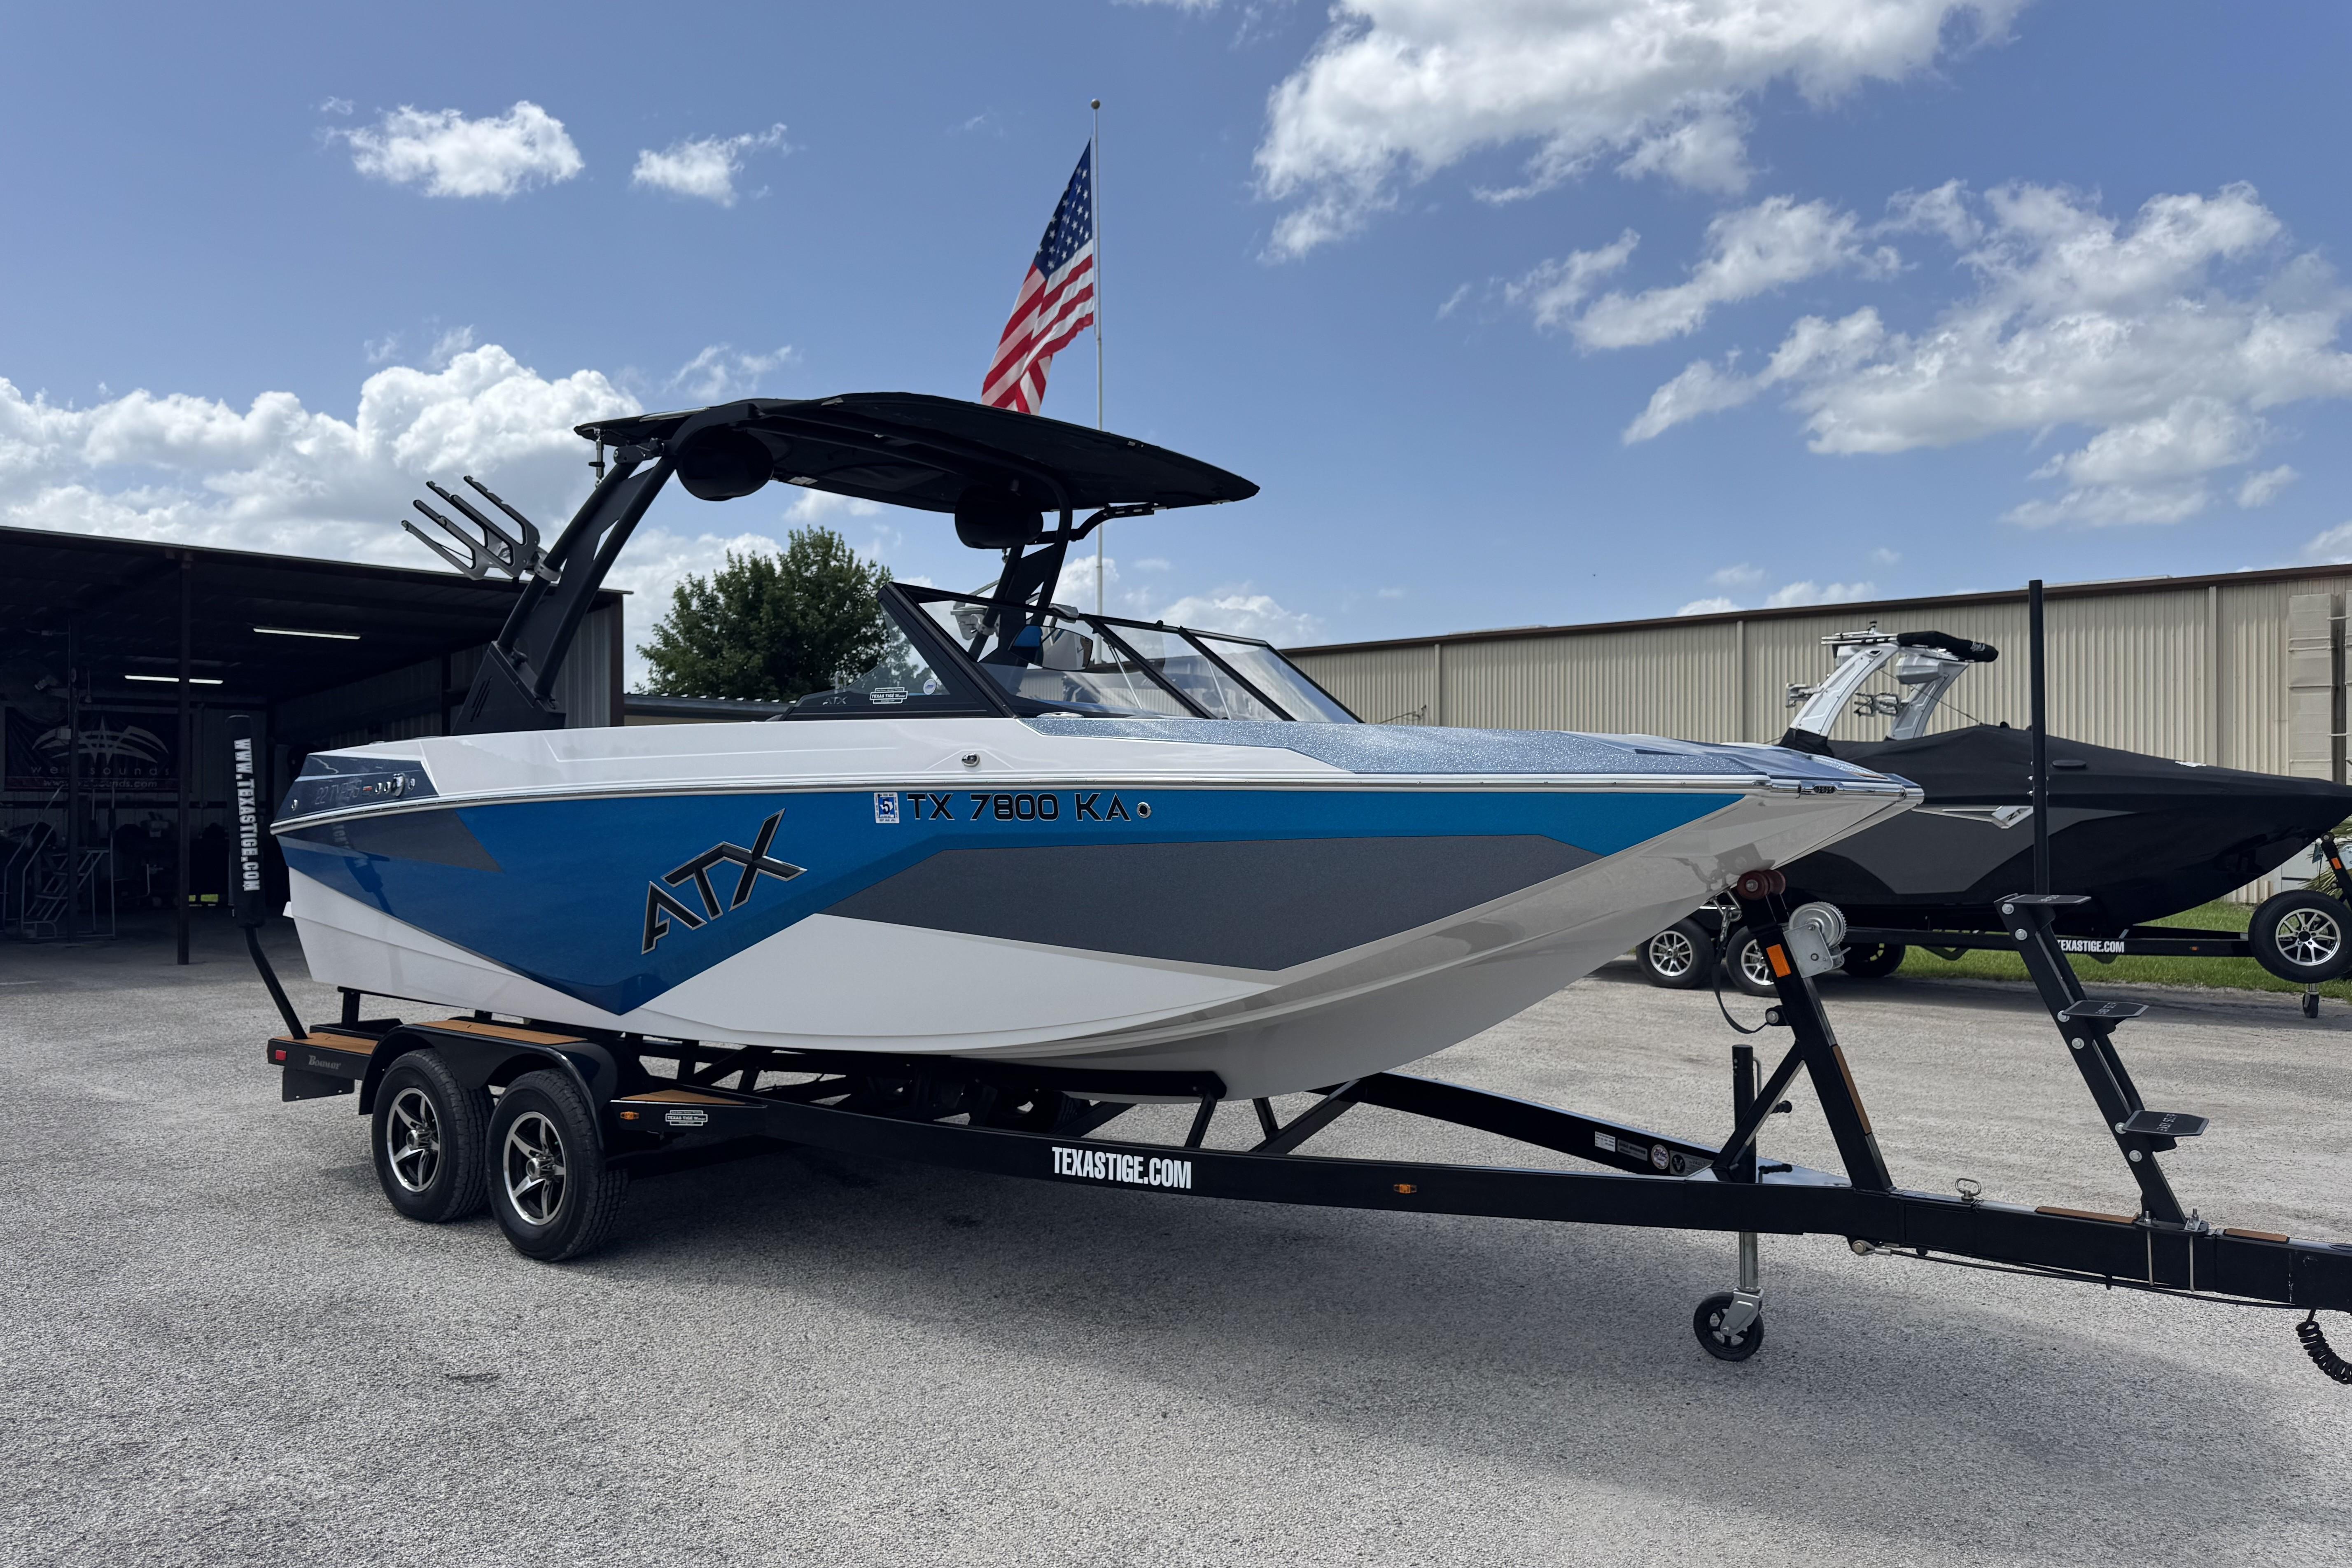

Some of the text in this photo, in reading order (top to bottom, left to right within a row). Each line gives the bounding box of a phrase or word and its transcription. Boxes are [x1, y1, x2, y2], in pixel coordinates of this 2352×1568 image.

[90, 763, 170, 775] sounds
[234, 738, 260, 891] WWW.TEXASTIGE.COM
[907, 793, 955, 821] TX
[970, 793, 1059, 821] 7800
[1074, 793, 1132, 821] KA
[641, 807, 808, 955] ATX
[1052, 1147, 1192, 1189] TEXASTIGE.COM
